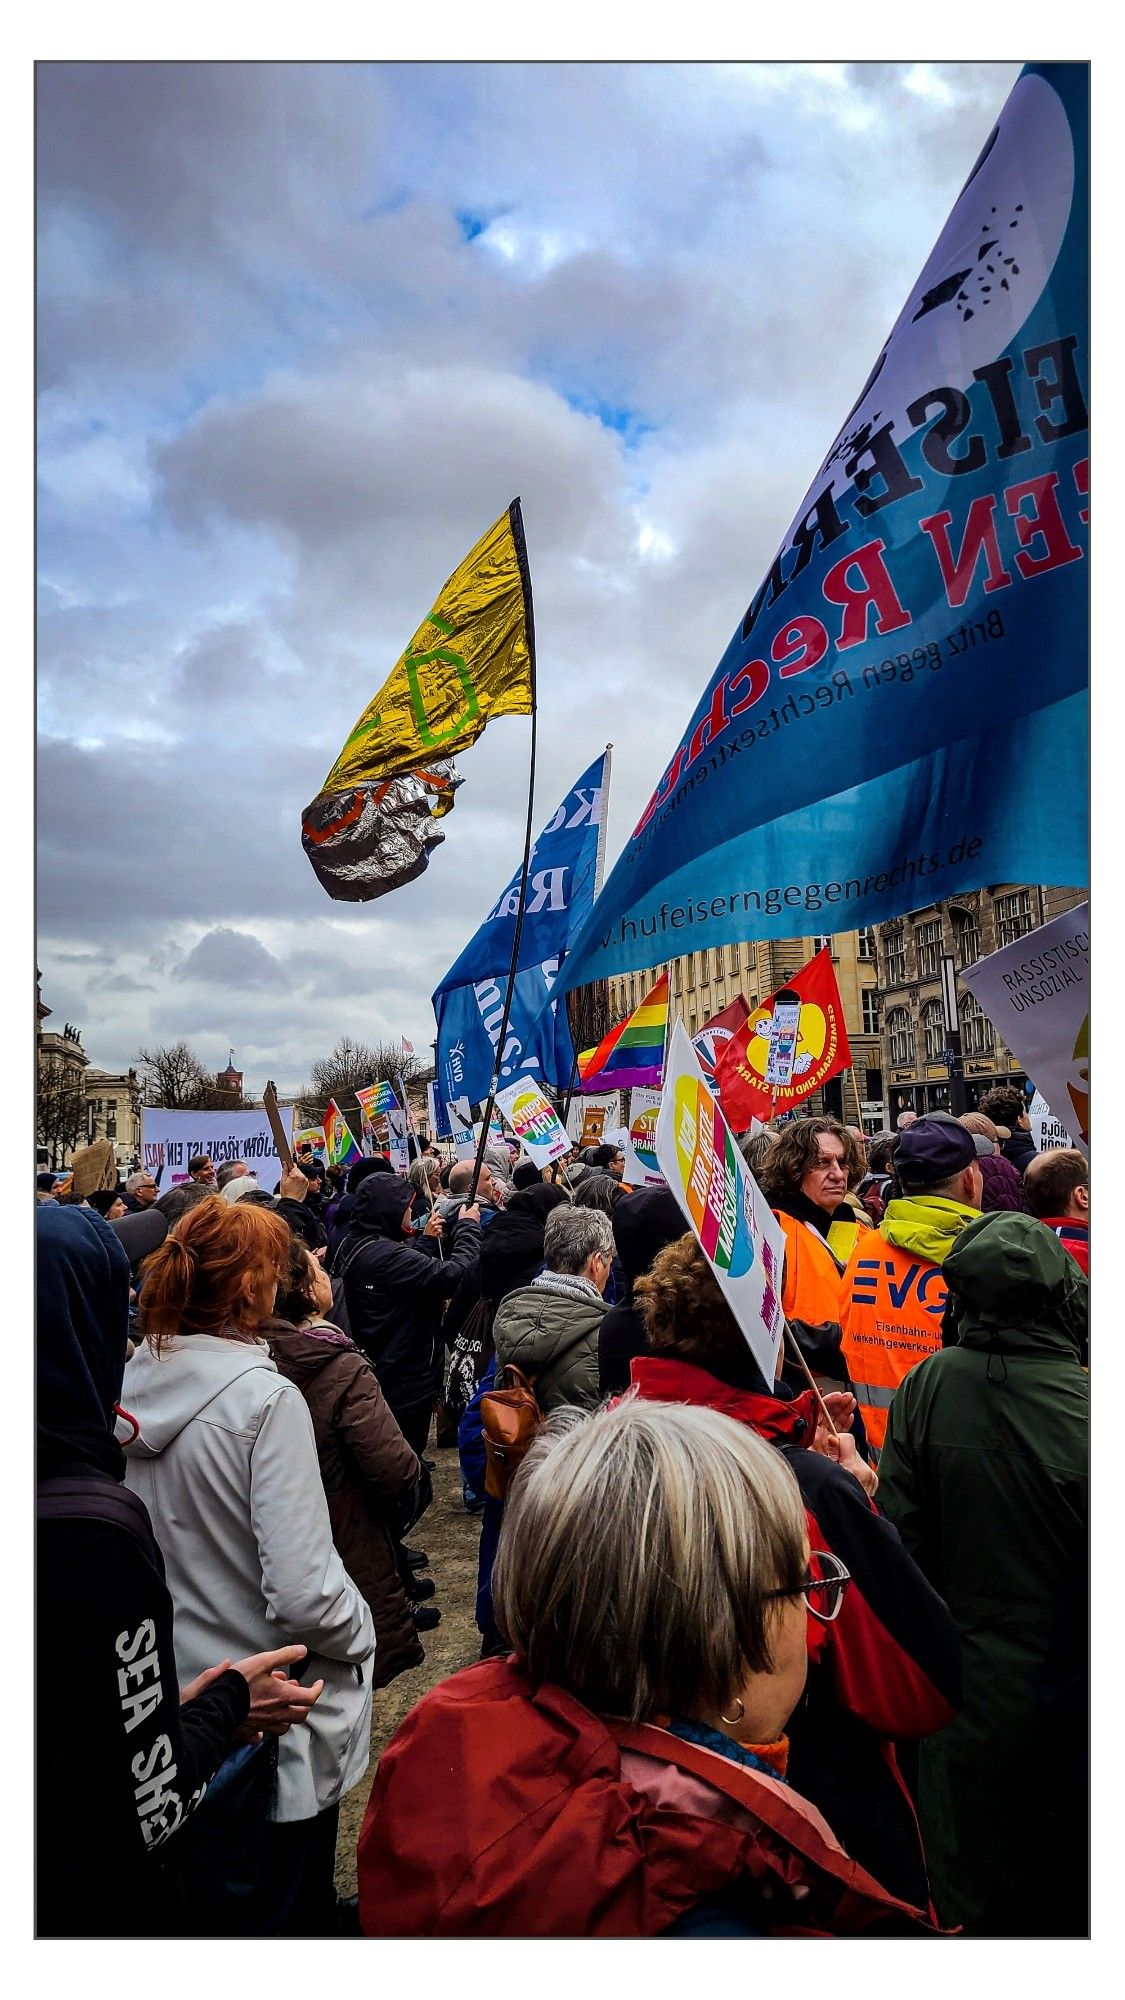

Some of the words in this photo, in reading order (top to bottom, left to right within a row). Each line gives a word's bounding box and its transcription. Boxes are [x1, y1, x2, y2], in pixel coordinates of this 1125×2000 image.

[1009, 966, 1083, 1012] UNSOZIAL
[451, 1056, 464, 1083] HVD
[528, 1111, 556, 1140] AFD
[677, 1101, 697, 1164] NEIN
[699, 1102, 714, 1169] HETZE
[690, 1154, 711, 1208] ZUR
[707, 1148, 726, 1224] GEGEN
[718, 1156, 738, 1262] MUSLIME
[851, 1260, 950, 1314] EVG
[875, 1320, 932, 1339] Eisenbahn-
[115, 1618, 164, 1734] SEA
